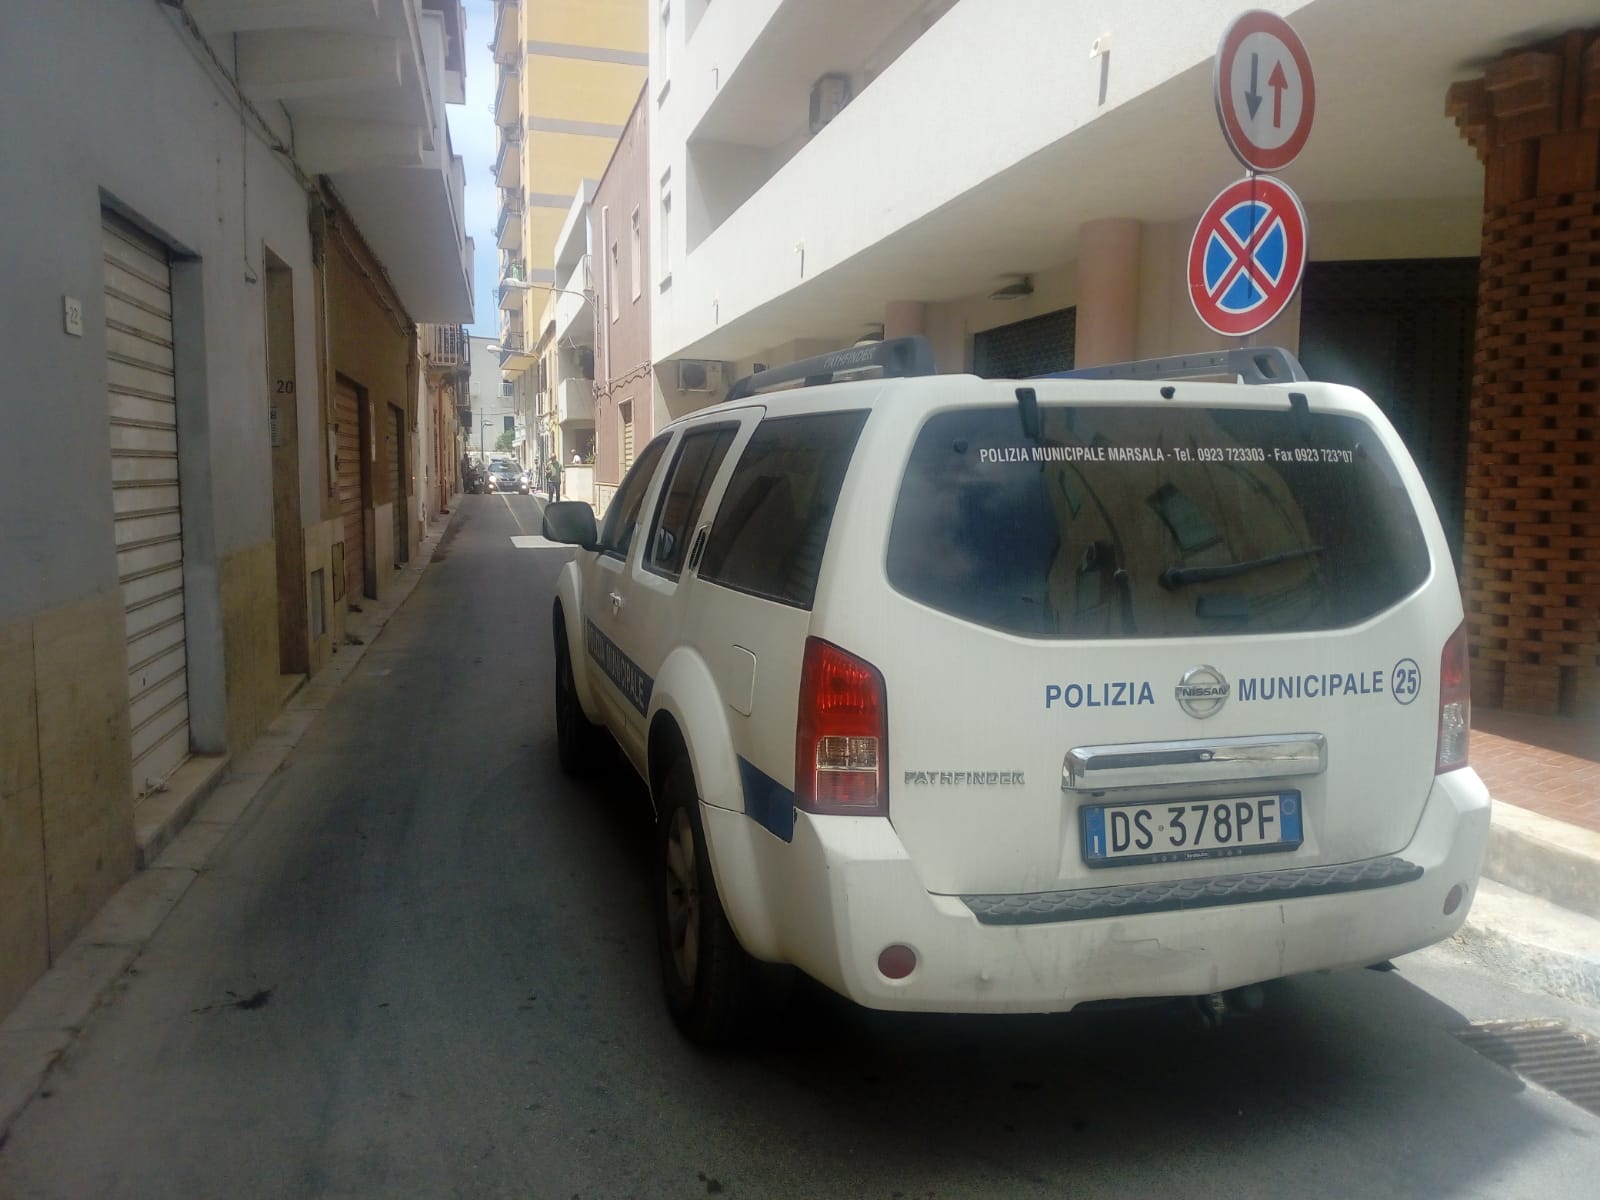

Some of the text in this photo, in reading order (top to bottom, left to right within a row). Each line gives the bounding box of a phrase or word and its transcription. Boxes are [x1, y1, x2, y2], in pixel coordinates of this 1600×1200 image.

[69, 305, 79, 325] 22
[277, 380, 294, 394] 20
[979, 448, 1029, 463] POLIZIA
[1032, 447, 1105, 461] MUNICIPALE
[1108, 447, 1164, 461] MARSALA
[1173, 447, 1195, 461] Tel.
[1197, 448, 1223, 461] 0923
[1226, 448, 1265, 461] 723303
[1274, 448, 1293, 461] Fax
[1294, 448, 1319, 461] 0923
[1046, 668, 1417, 708] POLIZIA MUNICIPALE 25
[1182, 687, 1227, 697] NISSAN
[904, 771, 1025, 785] PATHFINDER
[1110, 799, 1276, 852] DS 378PF
